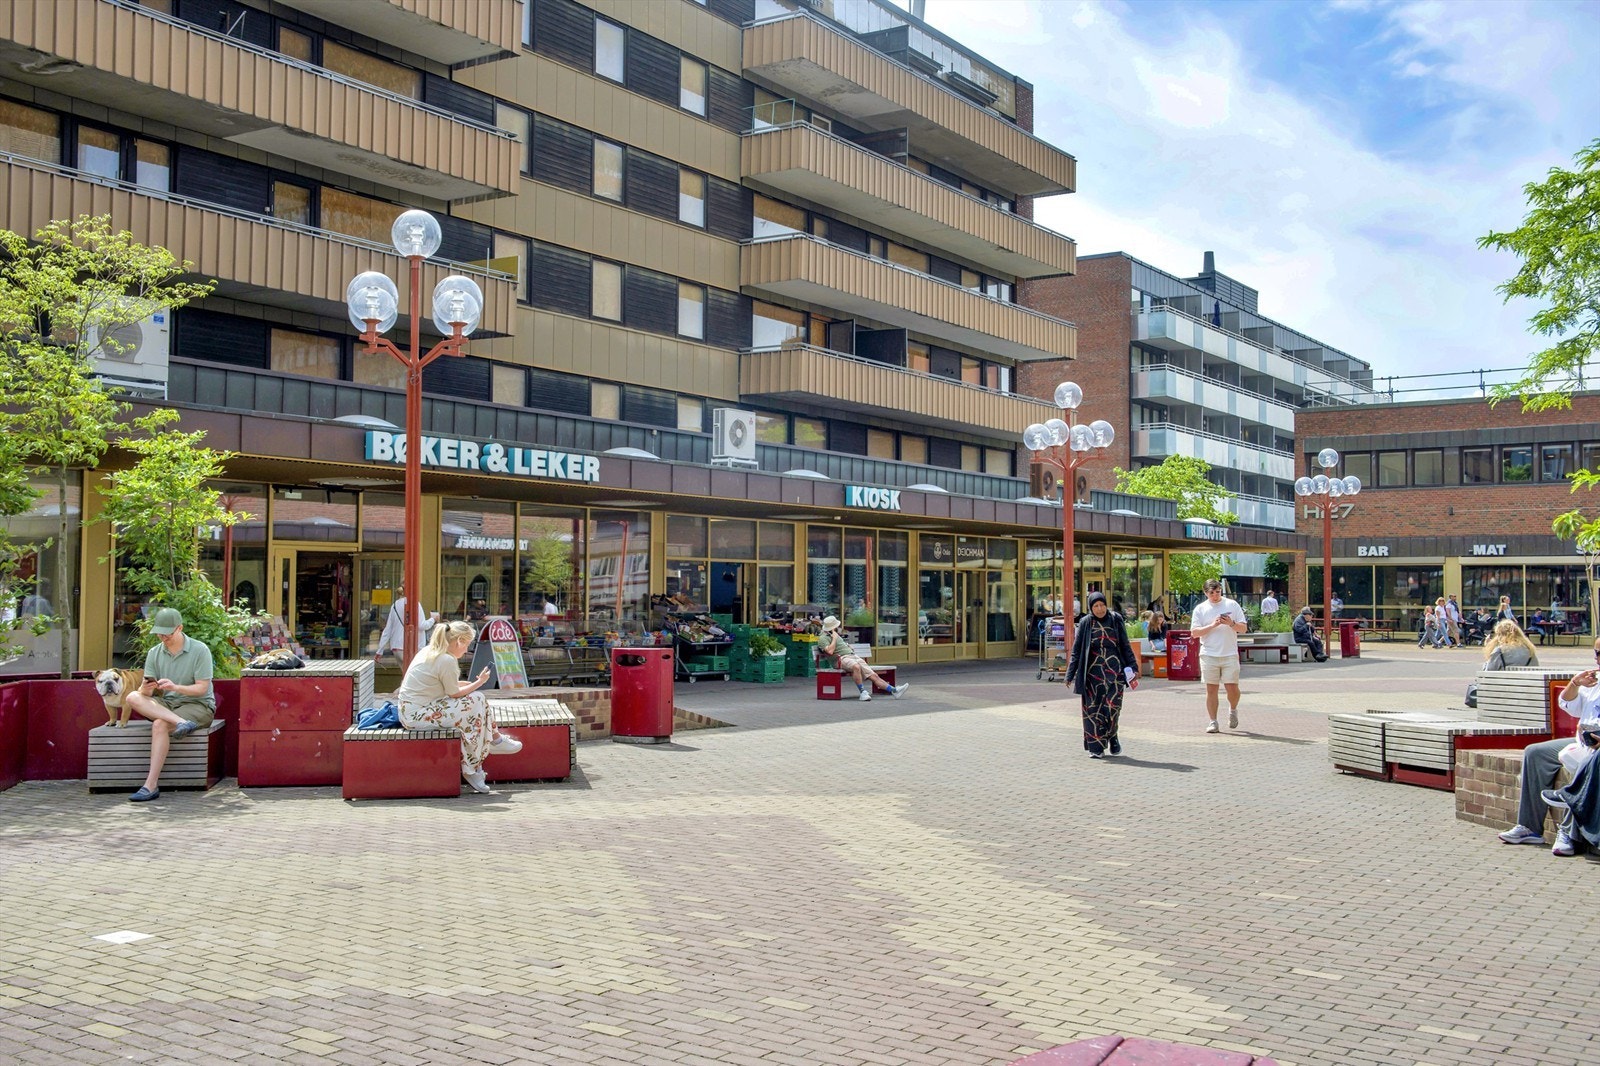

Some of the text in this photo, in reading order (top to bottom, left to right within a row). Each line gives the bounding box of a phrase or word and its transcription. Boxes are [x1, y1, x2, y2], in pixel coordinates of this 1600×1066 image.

[368, 431, 600, 482] BØKER & LEKER
[849, 486, 901, 510] KIOSK
[1187, 524, 1229, 541] BIBLIOTEK
[957, 548, 984, 557] DEICHMAN
[1358, 546, 1389, 557] BAR
[1473, 544, 1506, 555] MAT
